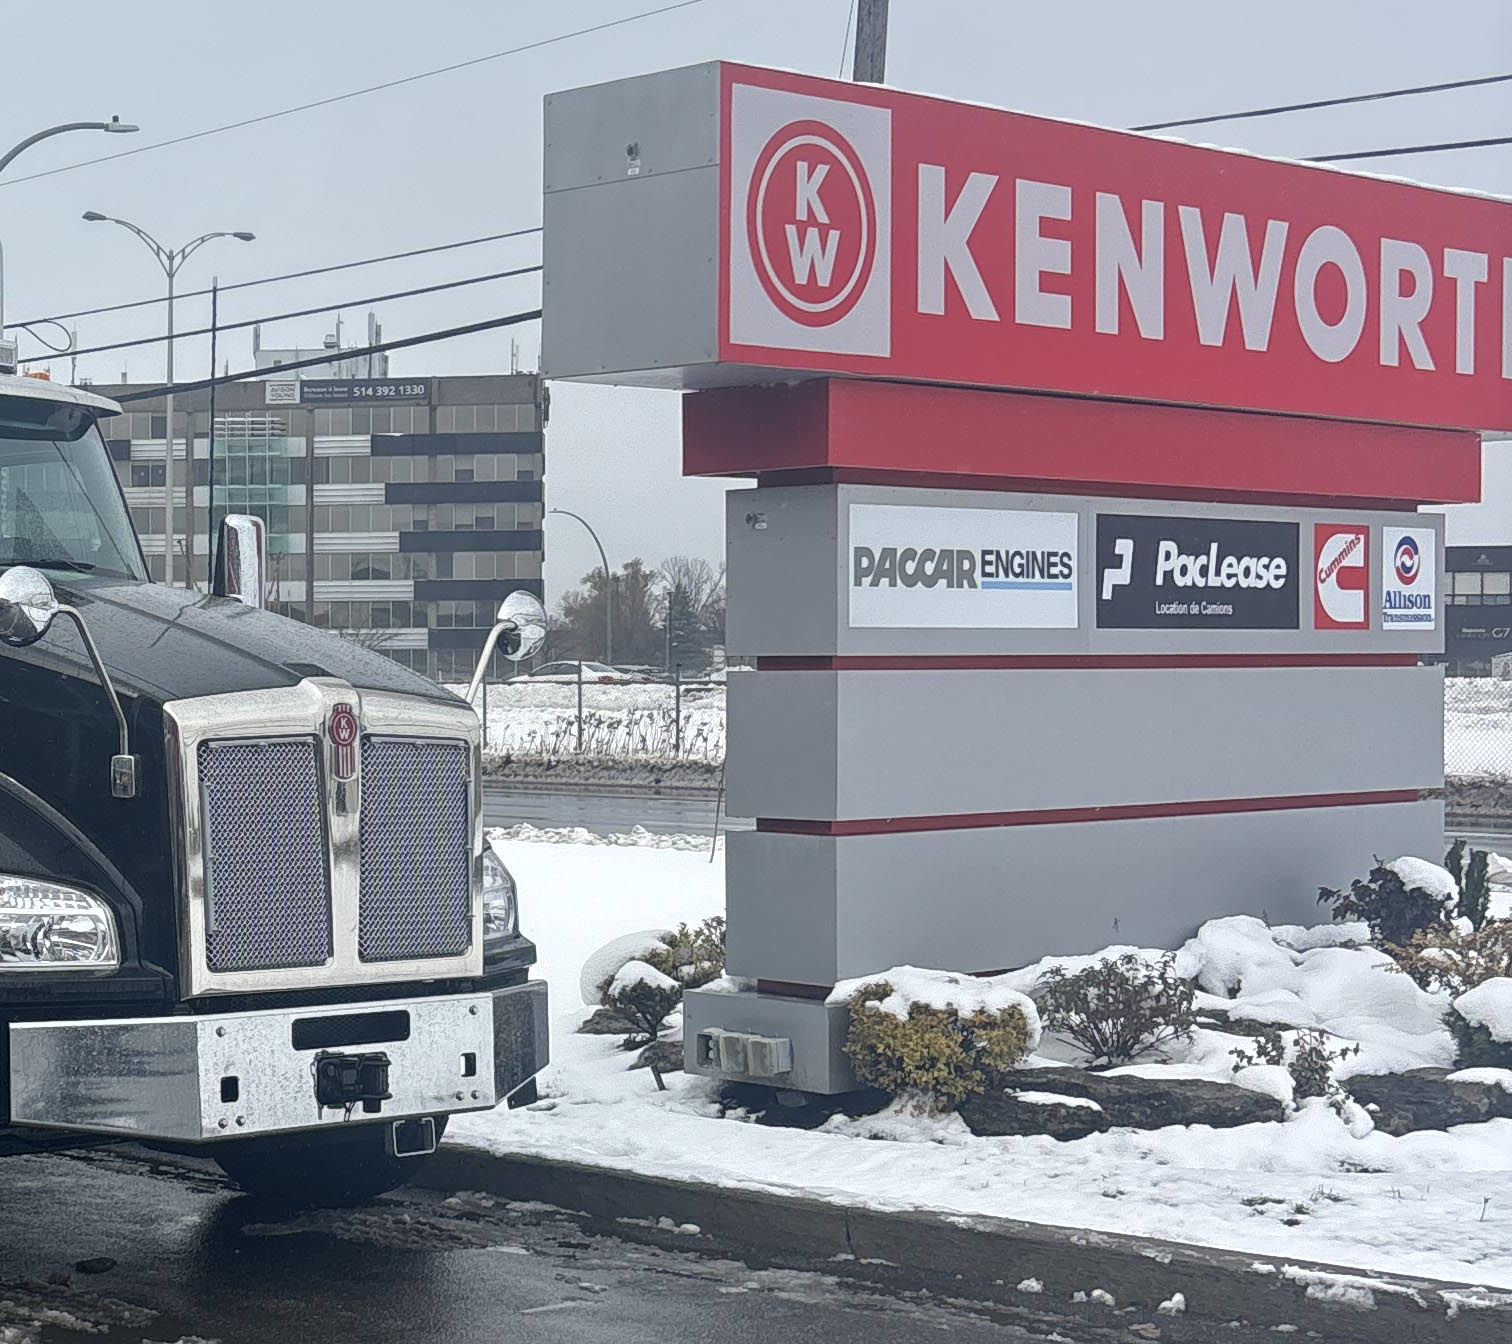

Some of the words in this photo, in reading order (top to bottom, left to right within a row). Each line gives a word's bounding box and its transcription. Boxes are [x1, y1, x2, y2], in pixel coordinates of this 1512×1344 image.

[353, 386, 373, 396] 514
[375, 385, 396, 396] 392
[398, 384, 425, 395] 1330
[853, 546, 978, 589] PACCAR
[981, 549, 1073, 580] ENGINES
[1155, 540, 1287, 589] PacLease
[1318, 534, 1361, 585] Cummins
[1155, 600, 1188, 615] Location
[1189, 600, 1200, 615] de
[1200, 601, 1233, 615] Camions
[1383, 590, 1432, 610] Allison
